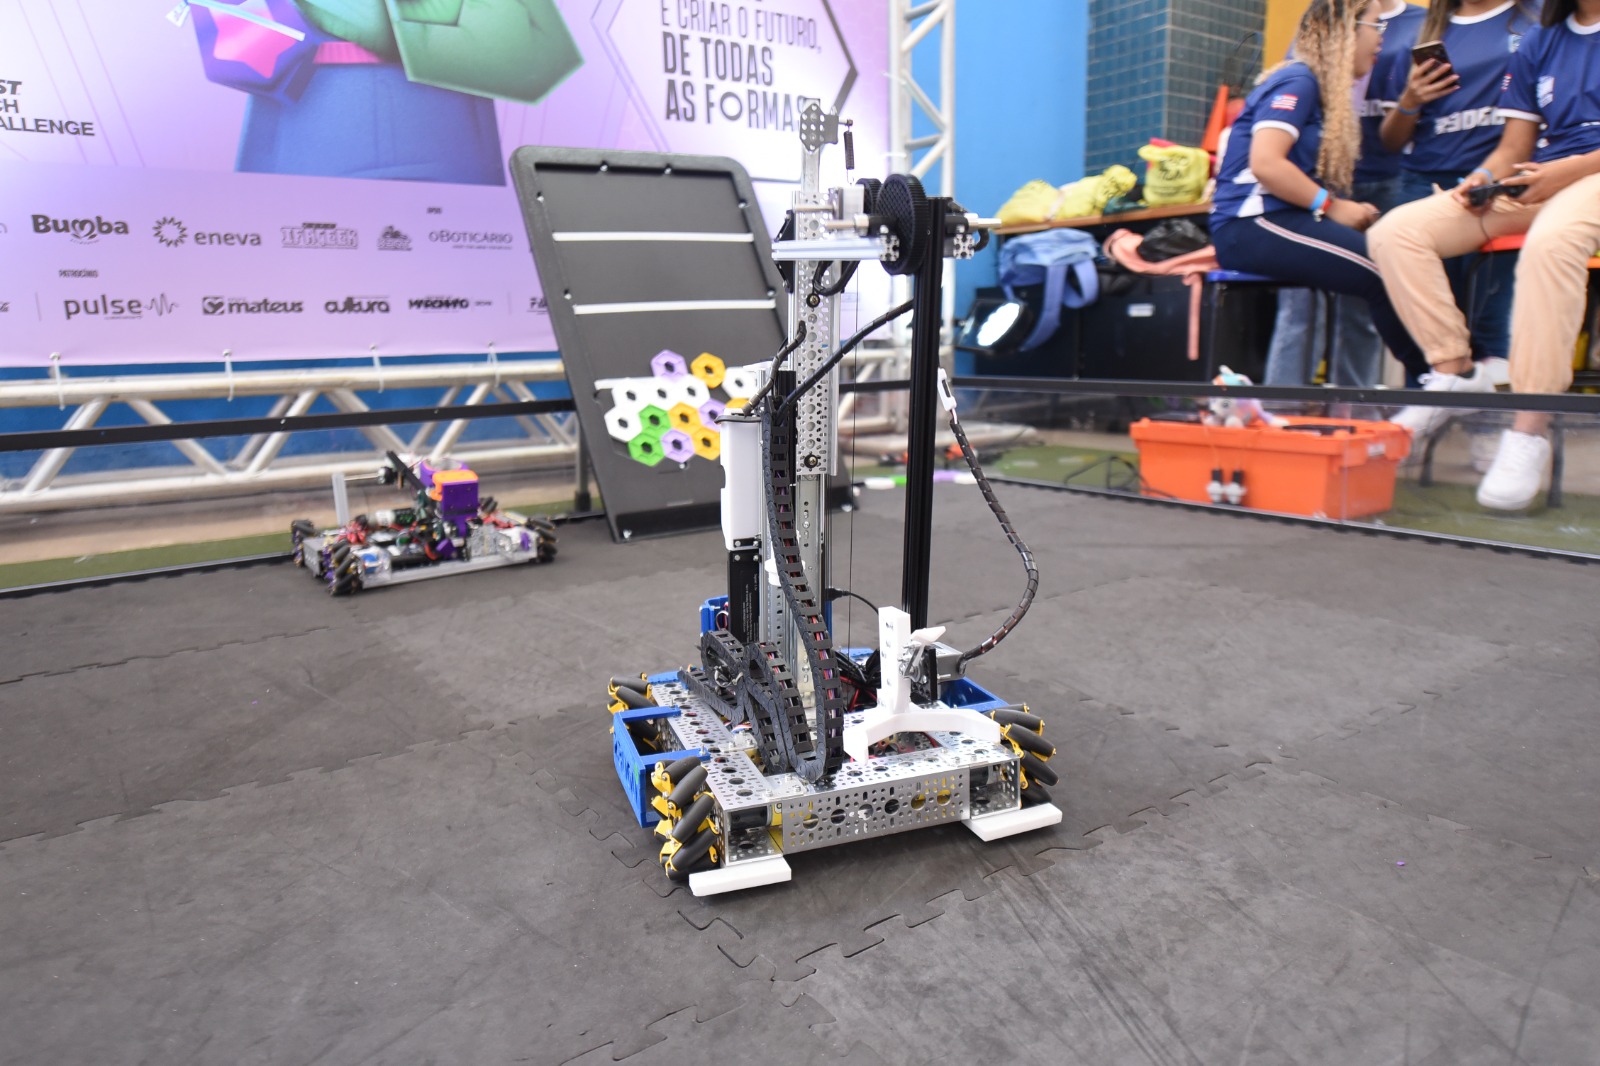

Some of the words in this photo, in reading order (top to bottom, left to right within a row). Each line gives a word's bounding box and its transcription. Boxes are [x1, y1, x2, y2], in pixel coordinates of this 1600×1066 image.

[660, 0, 670, 26] E
[677, 0, 731, 35] CRIAR
[738, 6, 748, 38] O
[662, 31, 691, 76] DE
[700, 37, 773, 86] TODAS
[665, 79, 696, 122] AS
[31, 214, 129, 240] Bumba
[194, 231, 262, 246] eneva
[64, 295, 143, 320] pulse
[228, 299, 304, 314] mateus
